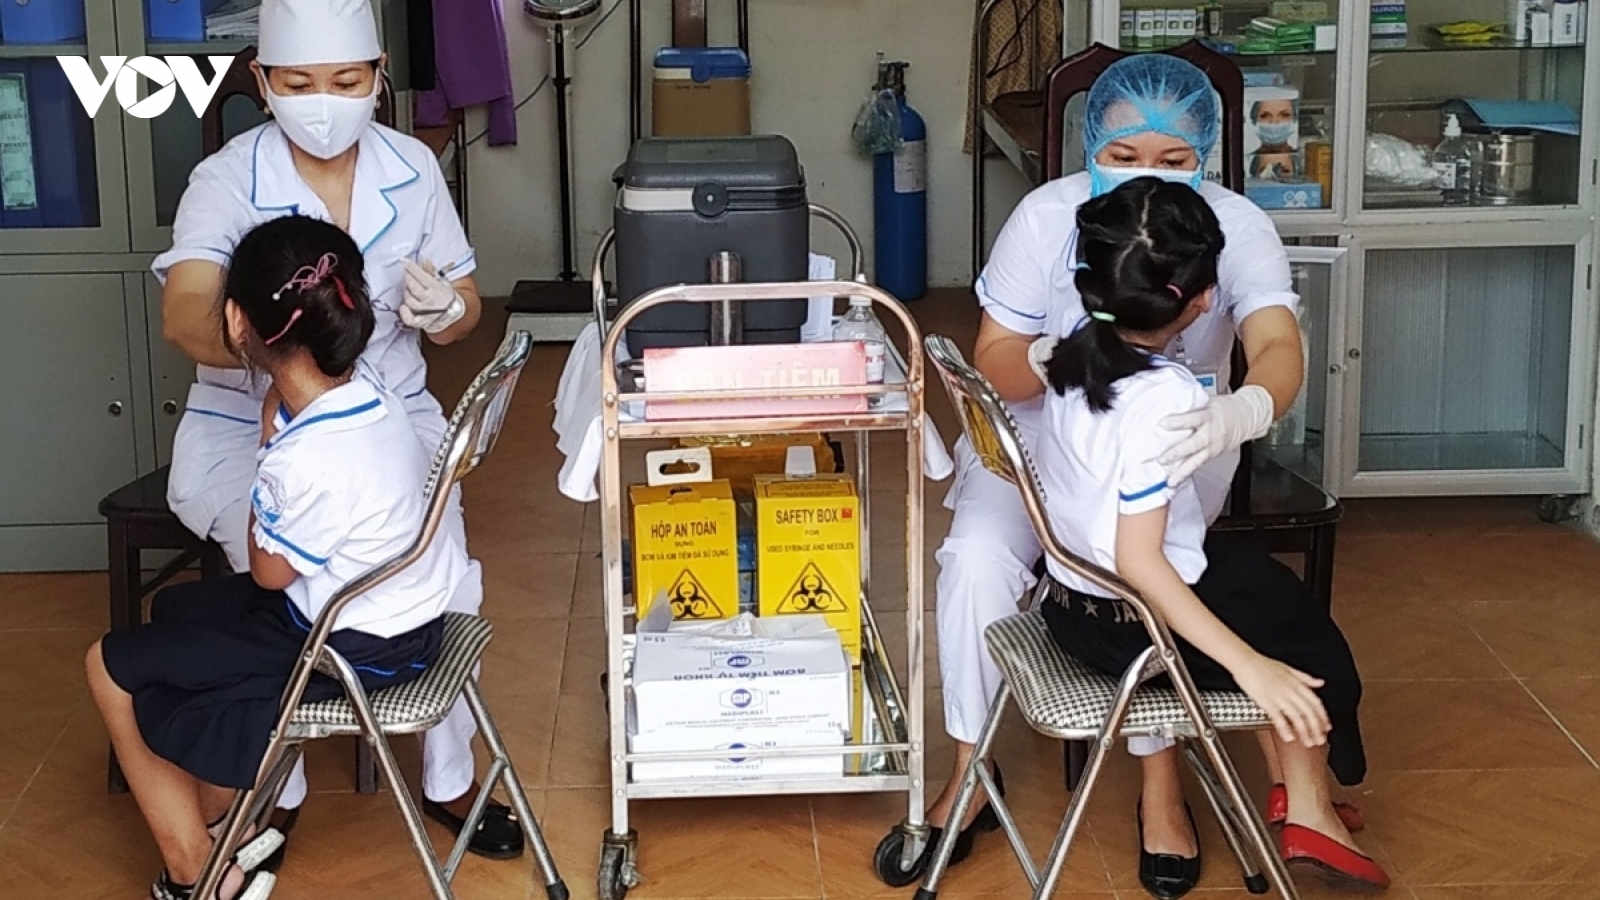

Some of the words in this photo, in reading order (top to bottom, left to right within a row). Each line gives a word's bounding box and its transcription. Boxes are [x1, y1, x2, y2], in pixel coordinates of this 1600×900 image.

[775, 508, 815, 525] SAFETY
[816, 507, 838, 523] BOX
[651, 519, 672, 542] HỘP
[674, 522, 688, 538] AN
[690, 516, 717, 536] TOÀN
[766, 545, 783, 553] USED
[812, 543, 825, 551] AND
[827, 541, 854, 550] NEEDLES
